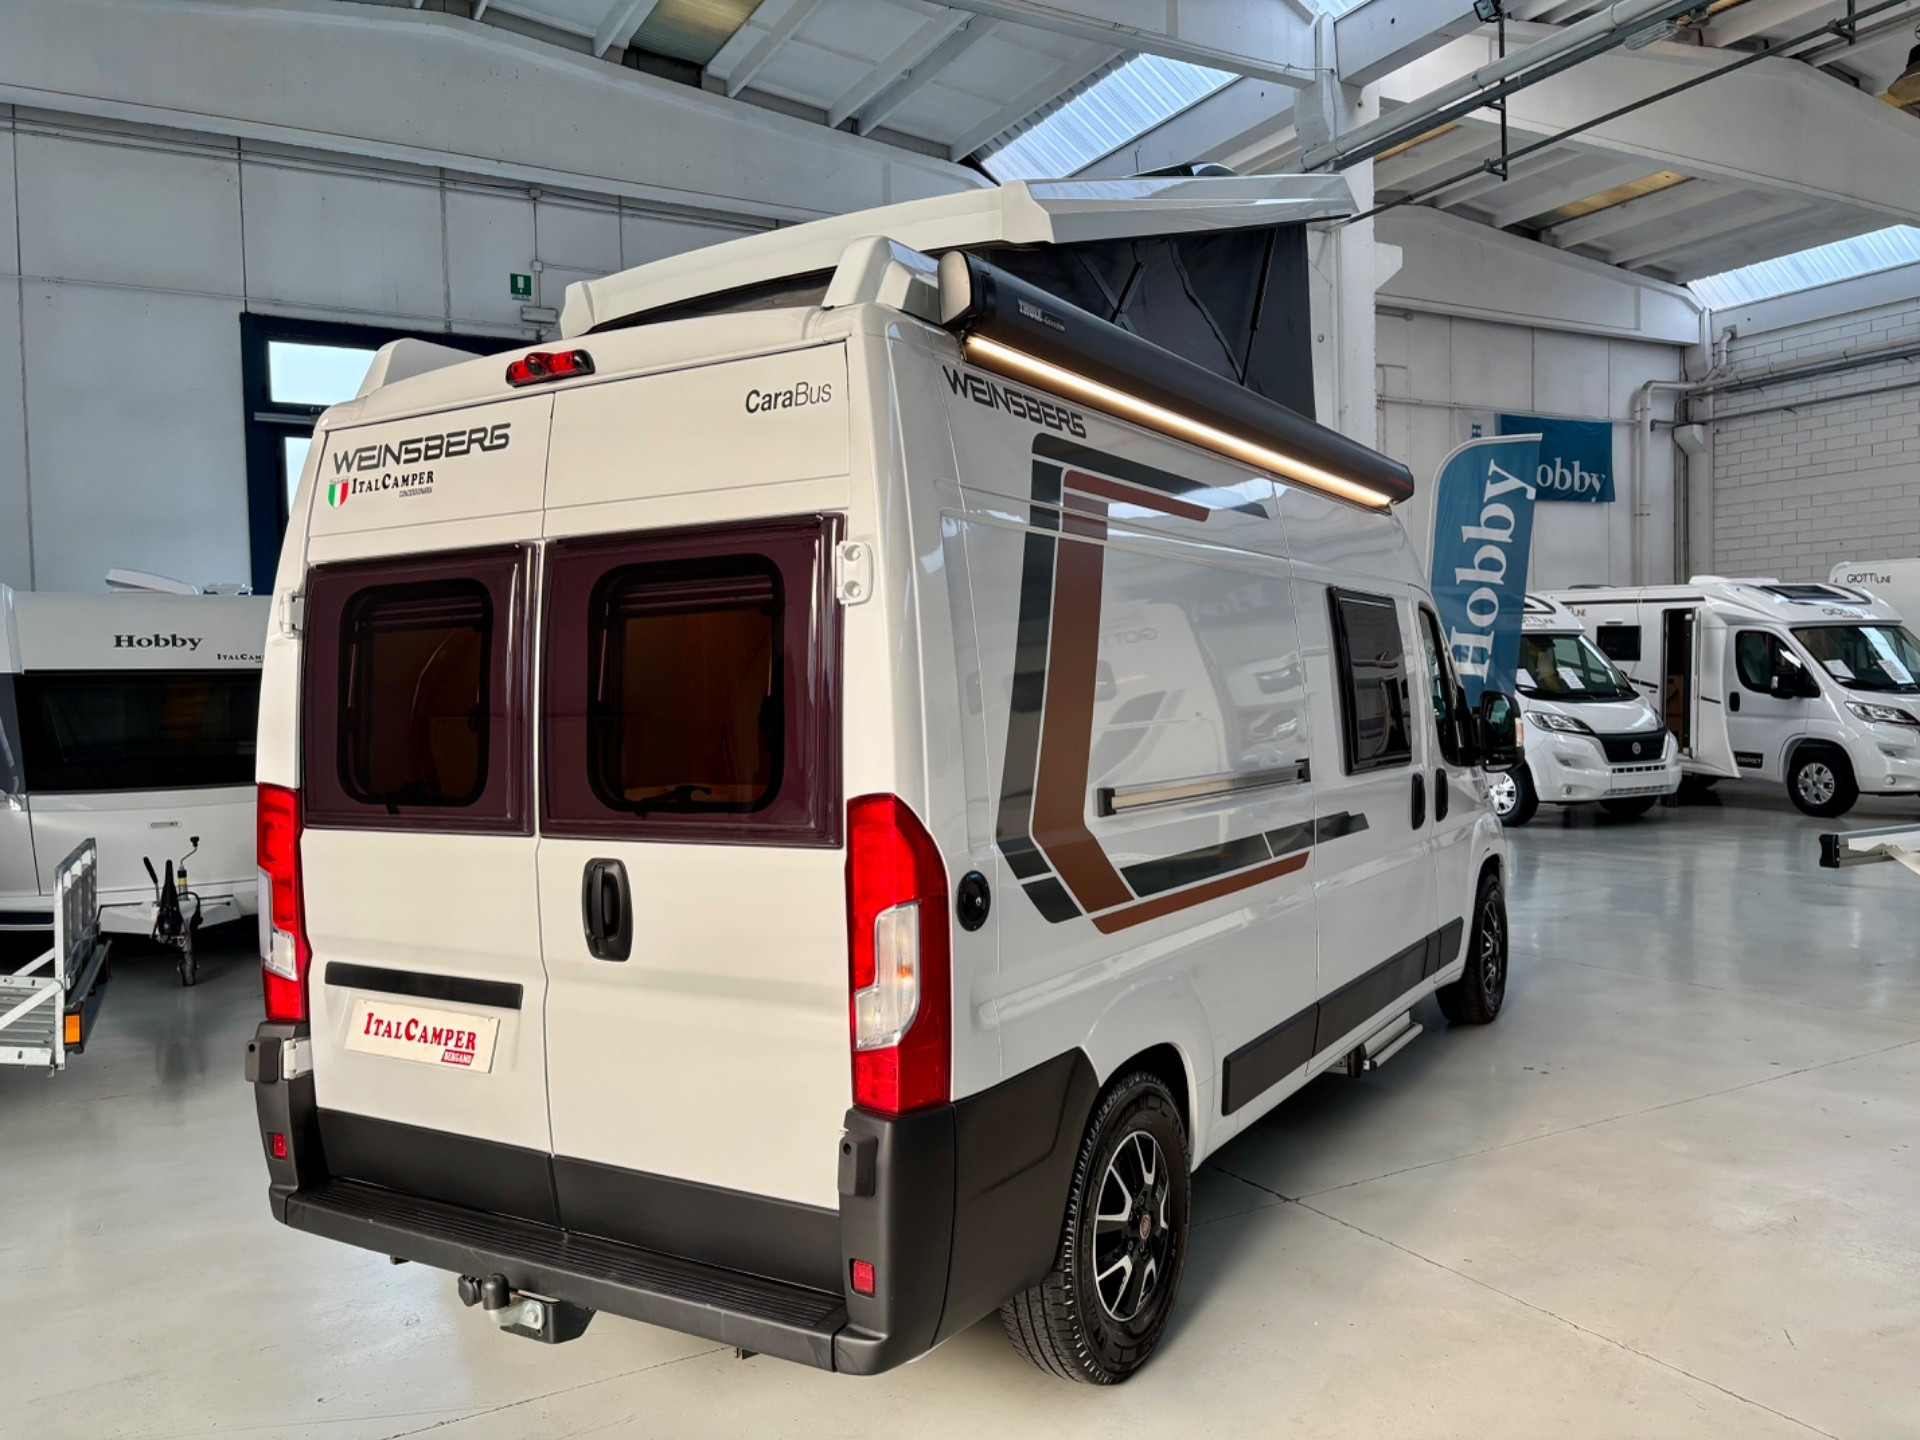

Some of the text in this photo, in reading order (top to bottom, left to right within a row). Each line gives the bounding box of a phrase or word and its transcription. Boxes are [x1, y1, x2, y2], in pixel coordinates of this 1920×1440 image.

[745, 381, 832, 414] CaraBus
[942, 365, 1087, 438] WEINSBERG
[333, 422, 512, 474] WEINSBERG
[1536, 457, 1606, 503] obby
[1451, 458, 1538, 684] Hobby
[113, 633, 203, 651] Hobby
